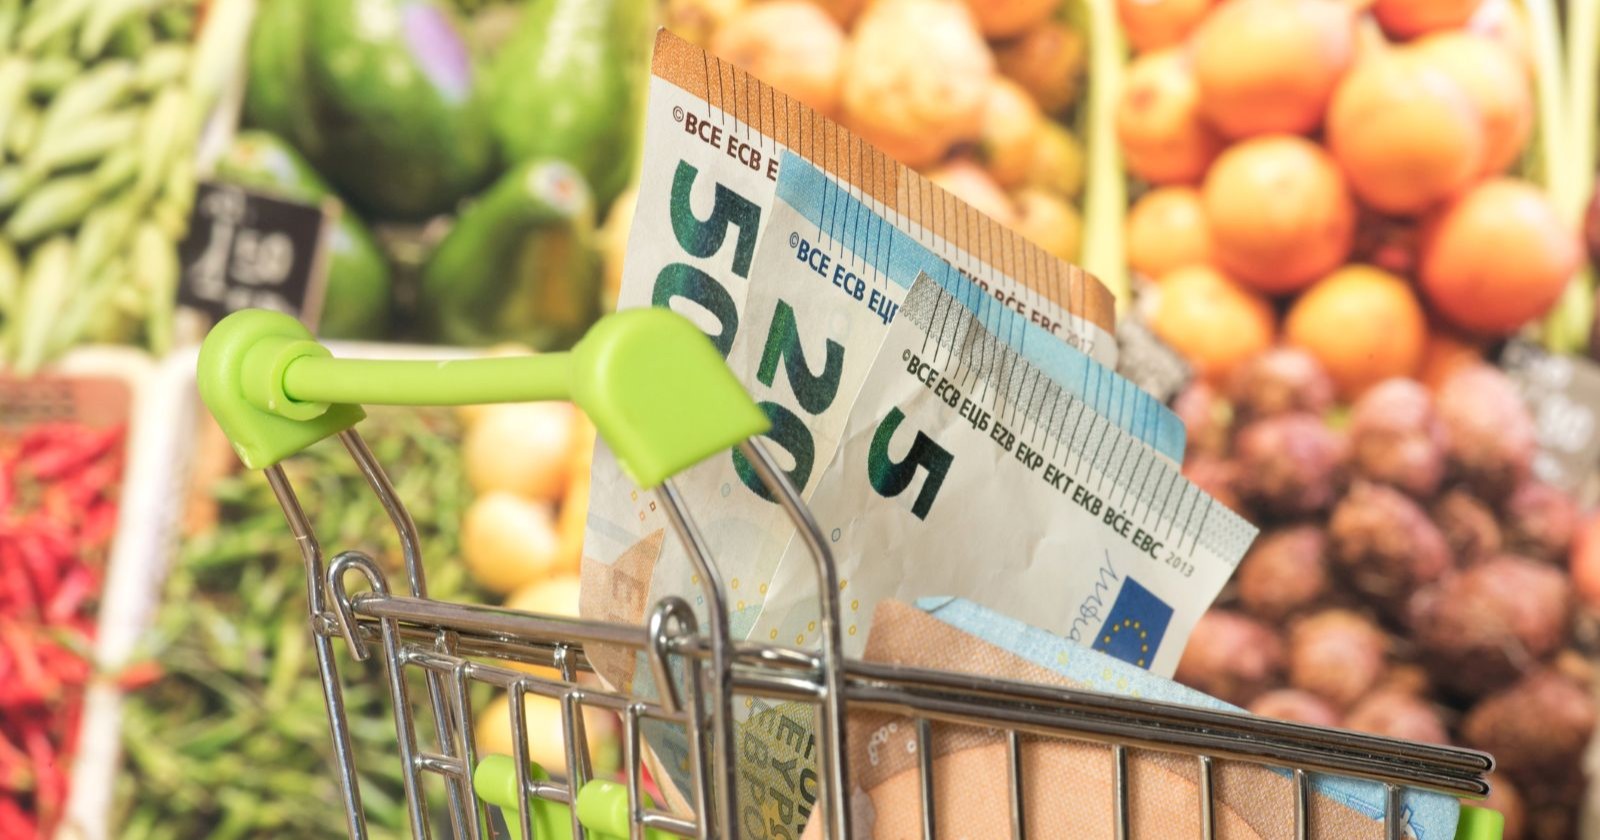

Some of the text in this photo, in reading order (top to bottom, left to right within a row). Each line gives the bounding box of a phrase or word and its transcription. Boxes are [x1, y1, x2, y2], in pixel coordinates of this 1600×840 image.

[726, 135, 762, 171] ECB
[652, 158, 762, 363] 50
[832, 261, 866, 301] ECB
[732, 298, 845, 504] 20
[867, 405, 955, 522] 5
[934, 378, 961, 408] ECB
[958, 399, 991, 431] ЕЦБ
[989, 421, 1016, 452] EZB
[1014, 442, 1044, 471] EKP
[1042, 463, 1074, 494] EKT
[1071, 484, 1103, 516] EKB
[1131, 528, 1164, 560] EBC
[1165, 551, 1195, 578] 2013
